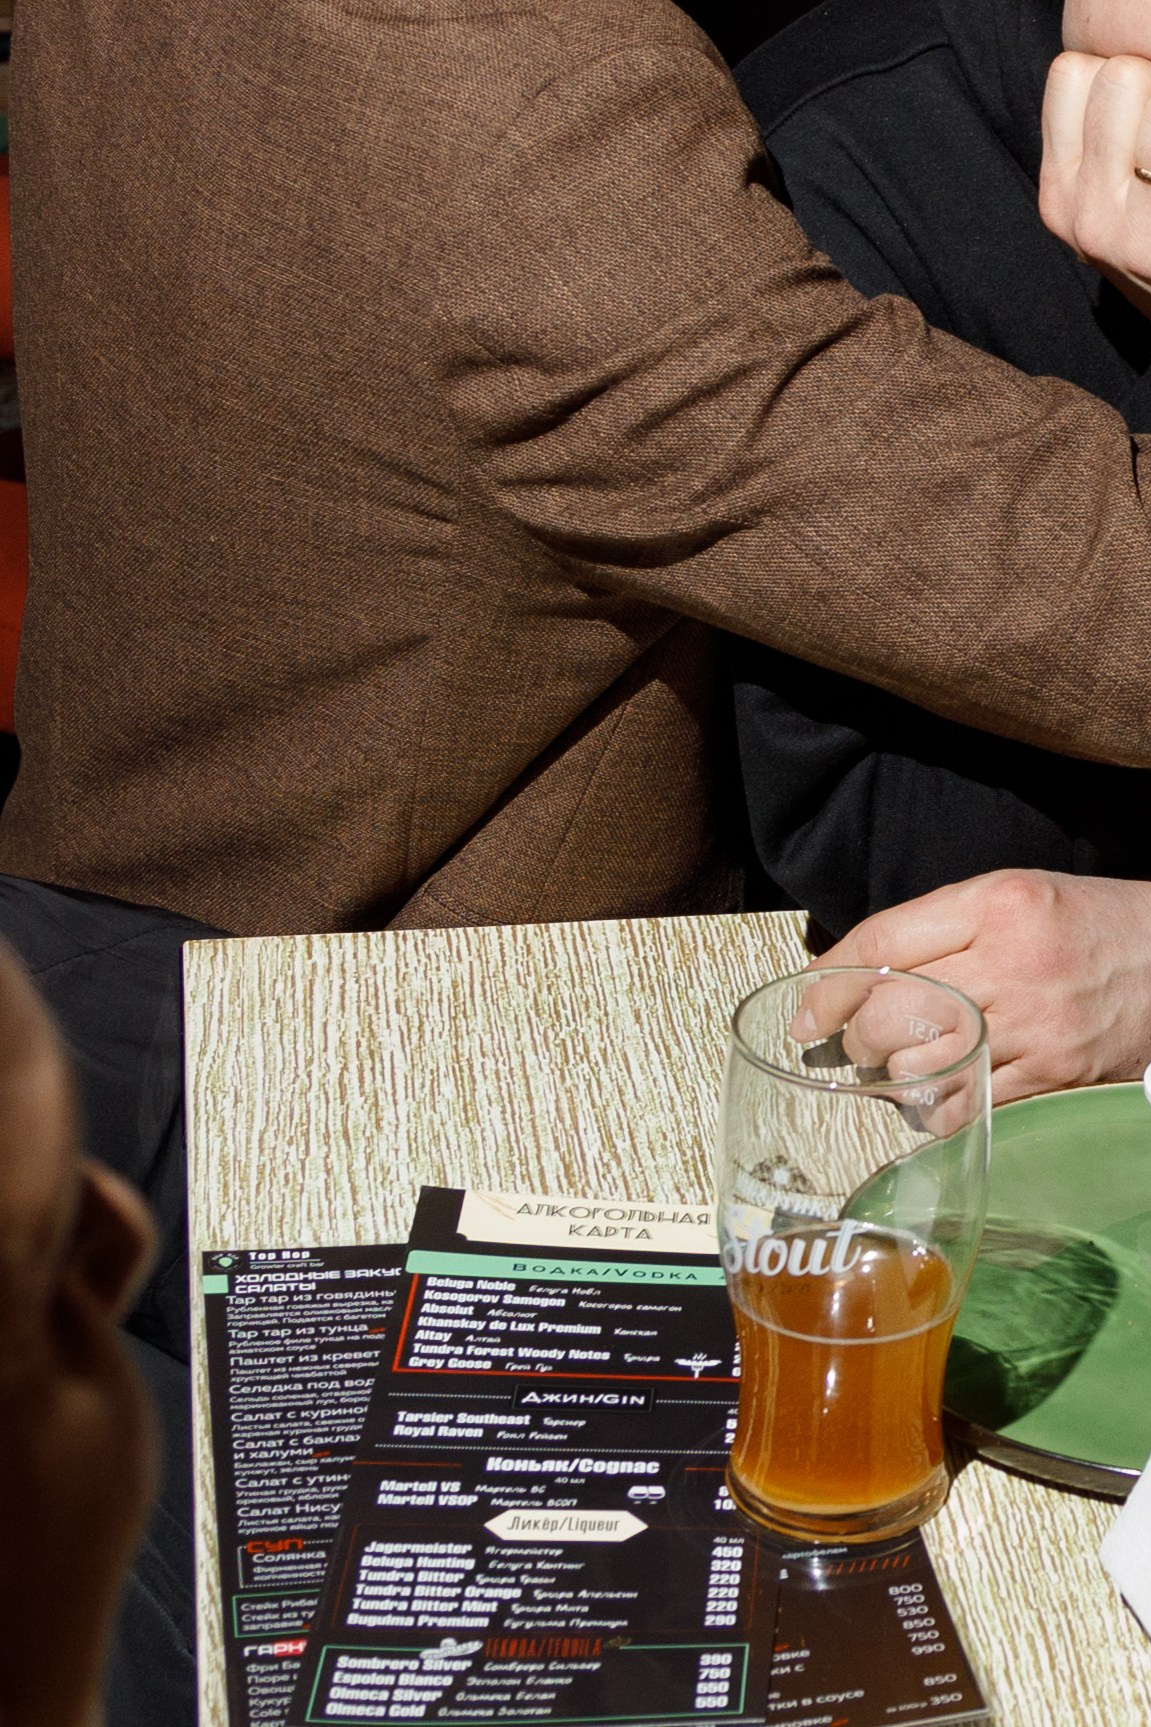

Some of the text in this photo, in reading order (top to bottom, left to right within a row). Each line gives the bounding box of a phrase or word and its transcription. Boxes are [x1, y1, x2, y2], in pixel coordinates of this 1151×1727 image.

[516, 1202, 711, 1225] АЛКОГОЛЬНАЯ
[568, 1223, 651, 1240] КАРТА
[248, 1251, 276, 1261] Top
[281, 1250, 310, 1259] Hop
[235, 1270, 340, 1283] ХОЛОДНЫЕ
[235, 1281, 316, 1294] САЛАТЫ
[426, 1276, 474, 1292] Beluga
[475, 1279, 516, 1291] Noble
[225, 1293, 312, 1306] Тар тар из
[423, 1290, 500, 1307] Kosogorov
[502, 1293, 565, 1308] Samogon
[420, 1303, 474, 1315] Absolut
[417, 1316, 486, 1333] Khanskay
[488, 1319, 507, 1330] de
[509, 1320, 535, 1332] Lux
[537, 1321, 601, 1334] Premium
[227, 1324, 368, 1340] Тар тар из тунца
[414, 1330, 452, 1344] Altay
[413, 1343, 464, 1355] Tundra
[465, 1345, 514, 1357] Forest
[517, 1347, 565, 1360] Woody
[568, 1349, 610, 1360] Notes
[230, 1353, 294, 1366] Паштет
[298, 1354, 318, 1362] из
[408, 1357, 445, 1369] Grey
[447, 1358, 492, 1369] Goose
[229, 1380, 340, 1395] Селедка под
[521, 1391, 644, 1404] ДЖИН/GIN
[231, 1409, 296, 1422] Салат с
[397, 1410, 454, 1423] Tarsier
[455, 1412, 530, 1425] Southeast
[393, 1425, 434, 1437] Royal
[437, 1425, 483, 1437] Raven
[232, 1437, 298, 1449] Салат с
[233, 1447, 313, 1460] и халуми
[485, 1456, 659, 1475] Коньяк/Cognac
[234, 1476, 302, 1488] Салат с
[380, 1479, 437, 1492] Martell
[440, 1481, 461, 1492] VS
[376, 1493, 435, 1505] Martell
[438, 1494, 478, 1506] VSOP
[237, 1505, 290, 1517] Салат
[507, 1515, 619, 1534] Ликёр/Liqueur
[246, 1538, 302, 1553] СУП
[364, 1541, 472, 1554] Jagermeister
[711, 1546, 743, 1557] 450
[252, 1550, 326, 1563] Солянка
[360, 1555, 414, 1569] Beluga
[416, 1555, 475, 1570] Hunting
[710, 1559, 741, 1571] 320
[359, 1569, 414, 1582] Tundra
[416, 1570, 464, 1583] Bitter
[708, 1573, 740, 1585] 220
[356, 1584, 411, 1596] Tundra
[413, 1585, 461, 1597] Bitter
[464, 1585, 522, 1599] Orange
[707, 1586, 739, 1598] 220
[888, 1583, 922, 1595] 800
[352, 1598, 408, 1611] Tundra
[410, 1599, 458, 1612] Bitter
[461, 1600, 498, 1612] Mint
[705, 1600, 737, 1612] 220
[894, 1593, 925, 1605] 750
[896, 1604, 928, 1617] 530
[346, 1613, 414, 1627] Bugulma
[417, 1614, 489, 1627] Premium
[902, 1617, 935, 1629] 850
[907, 1629, 939, 1642] 750
[911, 1642, 945, 1655] 990
[336, 1656, 419, 1670] Sombrero
[421, 1657, 472, 1671] Silver
[332, 1671, 395, 1686] Espolon
[397, 1672, 453, 1686] Blanco
[923, 1673, 957, 1686] 850
[329, 1686, 389, 1701] Olmeca
[391, 1687, 442, 1702] Silver
[930, 1692, 962, 1705] 350
[325, 1701, 426, 1717] Olmeca Gold
